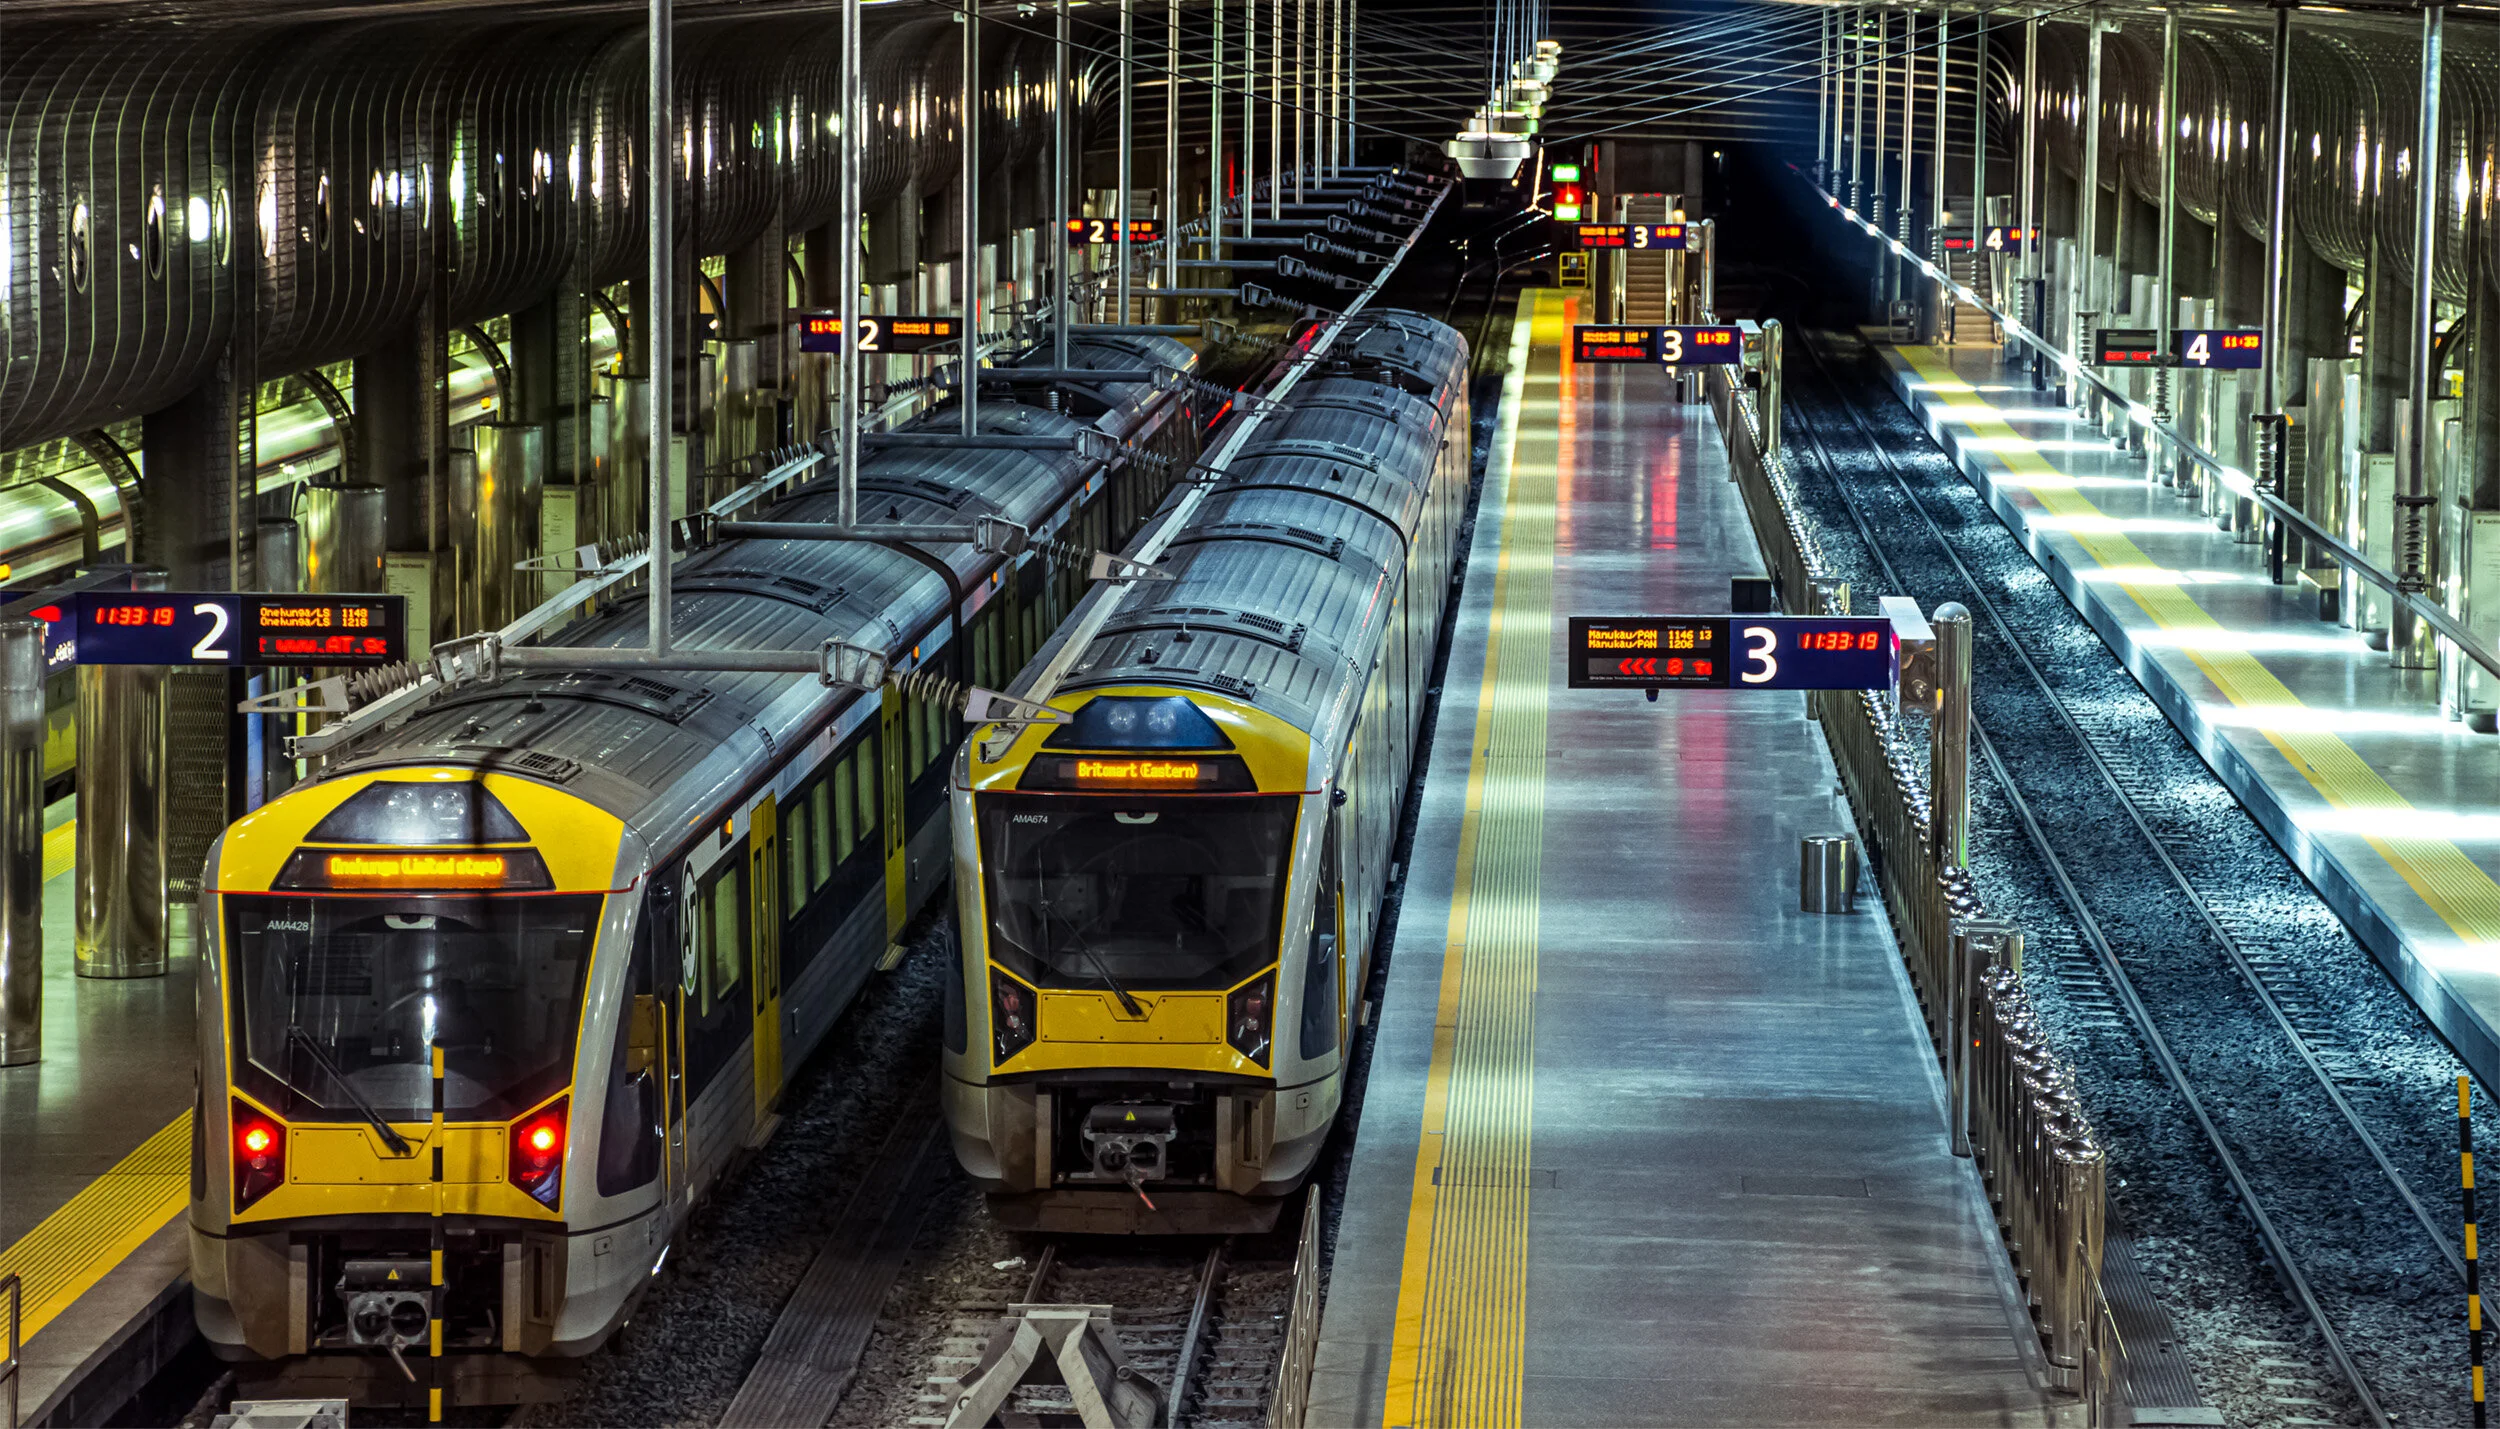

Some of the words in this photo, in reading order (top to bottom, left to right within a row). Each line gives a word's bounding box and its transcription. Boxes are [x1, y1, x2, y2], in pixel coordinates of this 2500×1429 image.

[1089, 219, 1105, 243] 2
[1633, 225, 1649, 249] 3
[1986, 227, 2004, 251] 4
[858, 319, 879, 351] 2
[1662, 329, 1683, 362] 3
[1695, 331, 1731, 346] 11:33
[2222, 335, 2260, 349] 11:33
[2186, 333, 2211, 366] 4
[96, 606, 175, 627] 11:33:19
[260, 607, 332, 618] Onehunga/LS
[342, 608, 368, 618] 1148
[260, 617, 332, 628] Onehunga/LS
[342, 618, 368, 628] 1218
[191, 602, 230, 660] 2
[1588, 630, 1657, 640] Manukau/PAN
[1668, 630, 1694, 640] 1146
[1699, 630, 1712, 640] 13
[1801, 630, 1879, 651] 11:33:19
[1588, 639, 1657, 649] Manukau/PAN
[1668, 640, 1694, 649] 1206
[1741, 626, 1778, 684] 3
[1077, 760, 1138, 778] Britomart
[1139, 762, 1198, 780] (Eastern)
[1012, 814, 1049, 825] AMA674
[266, 919, 309, 932] AMA428
[683, 891, 696, 961] AT
